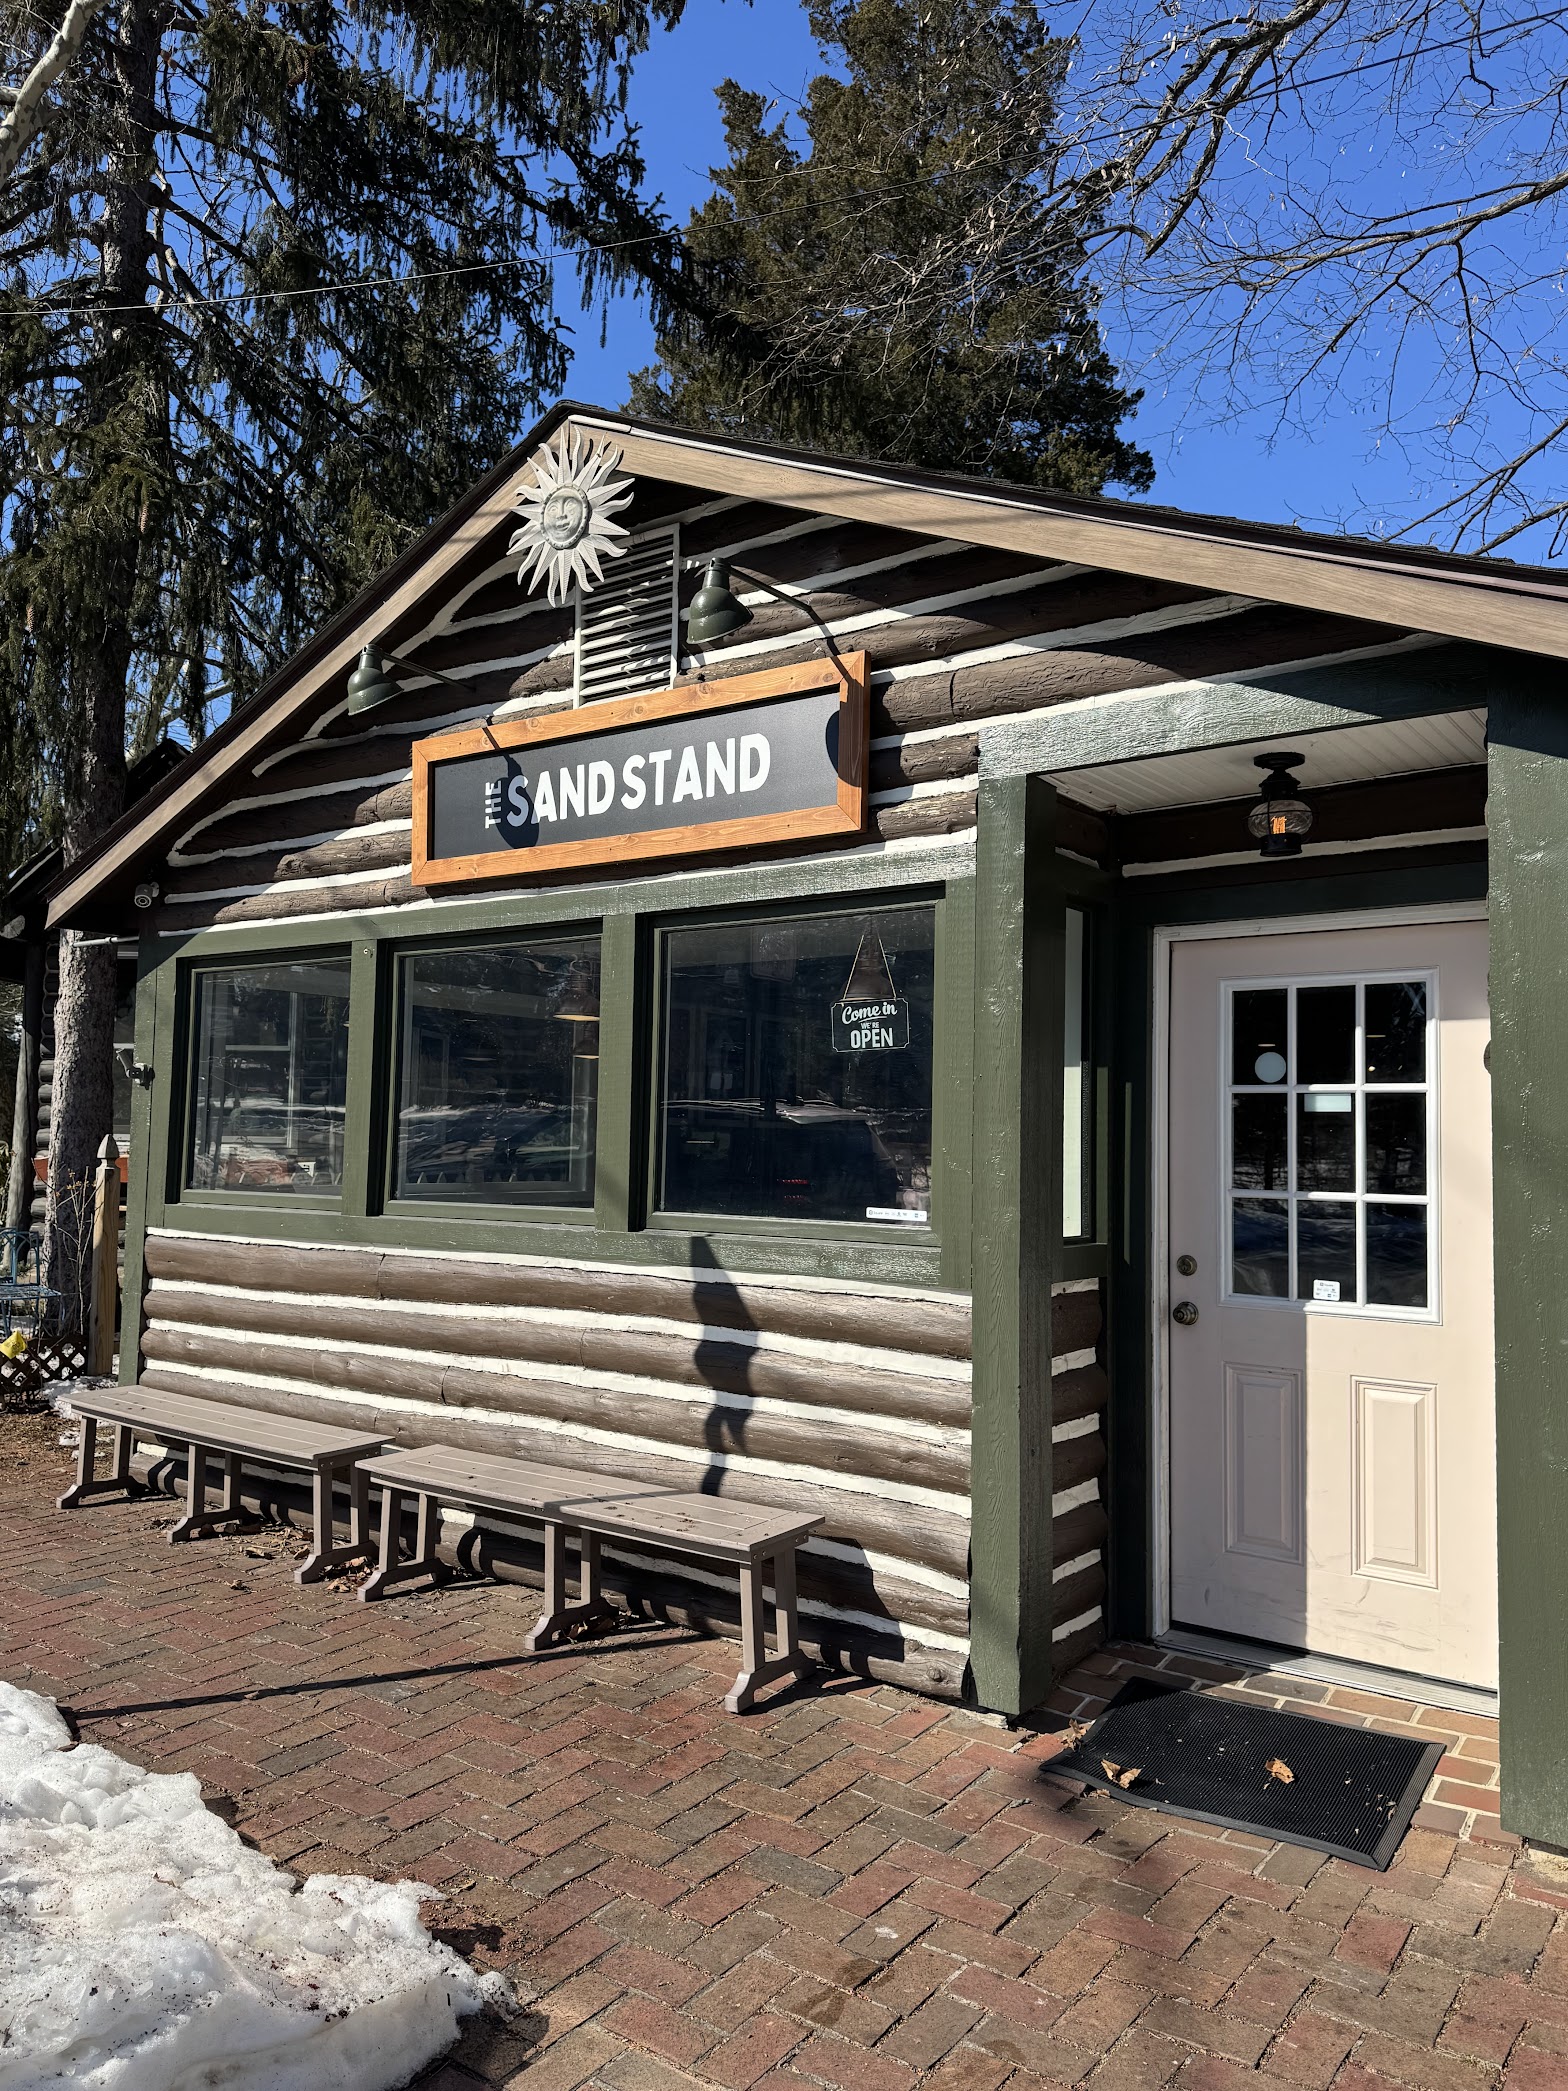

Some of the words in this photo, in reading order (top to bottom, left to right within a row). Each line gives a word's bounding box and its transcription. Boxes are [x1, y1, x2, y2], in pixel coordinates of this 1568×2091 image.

[507, 760, 615, 827] SAND
[621, 733, 771, 810] STAND
[485, 780, 501, 829] THE
[842, 1006, 881, 1025] Come
[882, 1001, 898, 1016] in
[860, 1021, 880, 1029] WE'RE
[850, 1027, 894, 1049] OPEN
